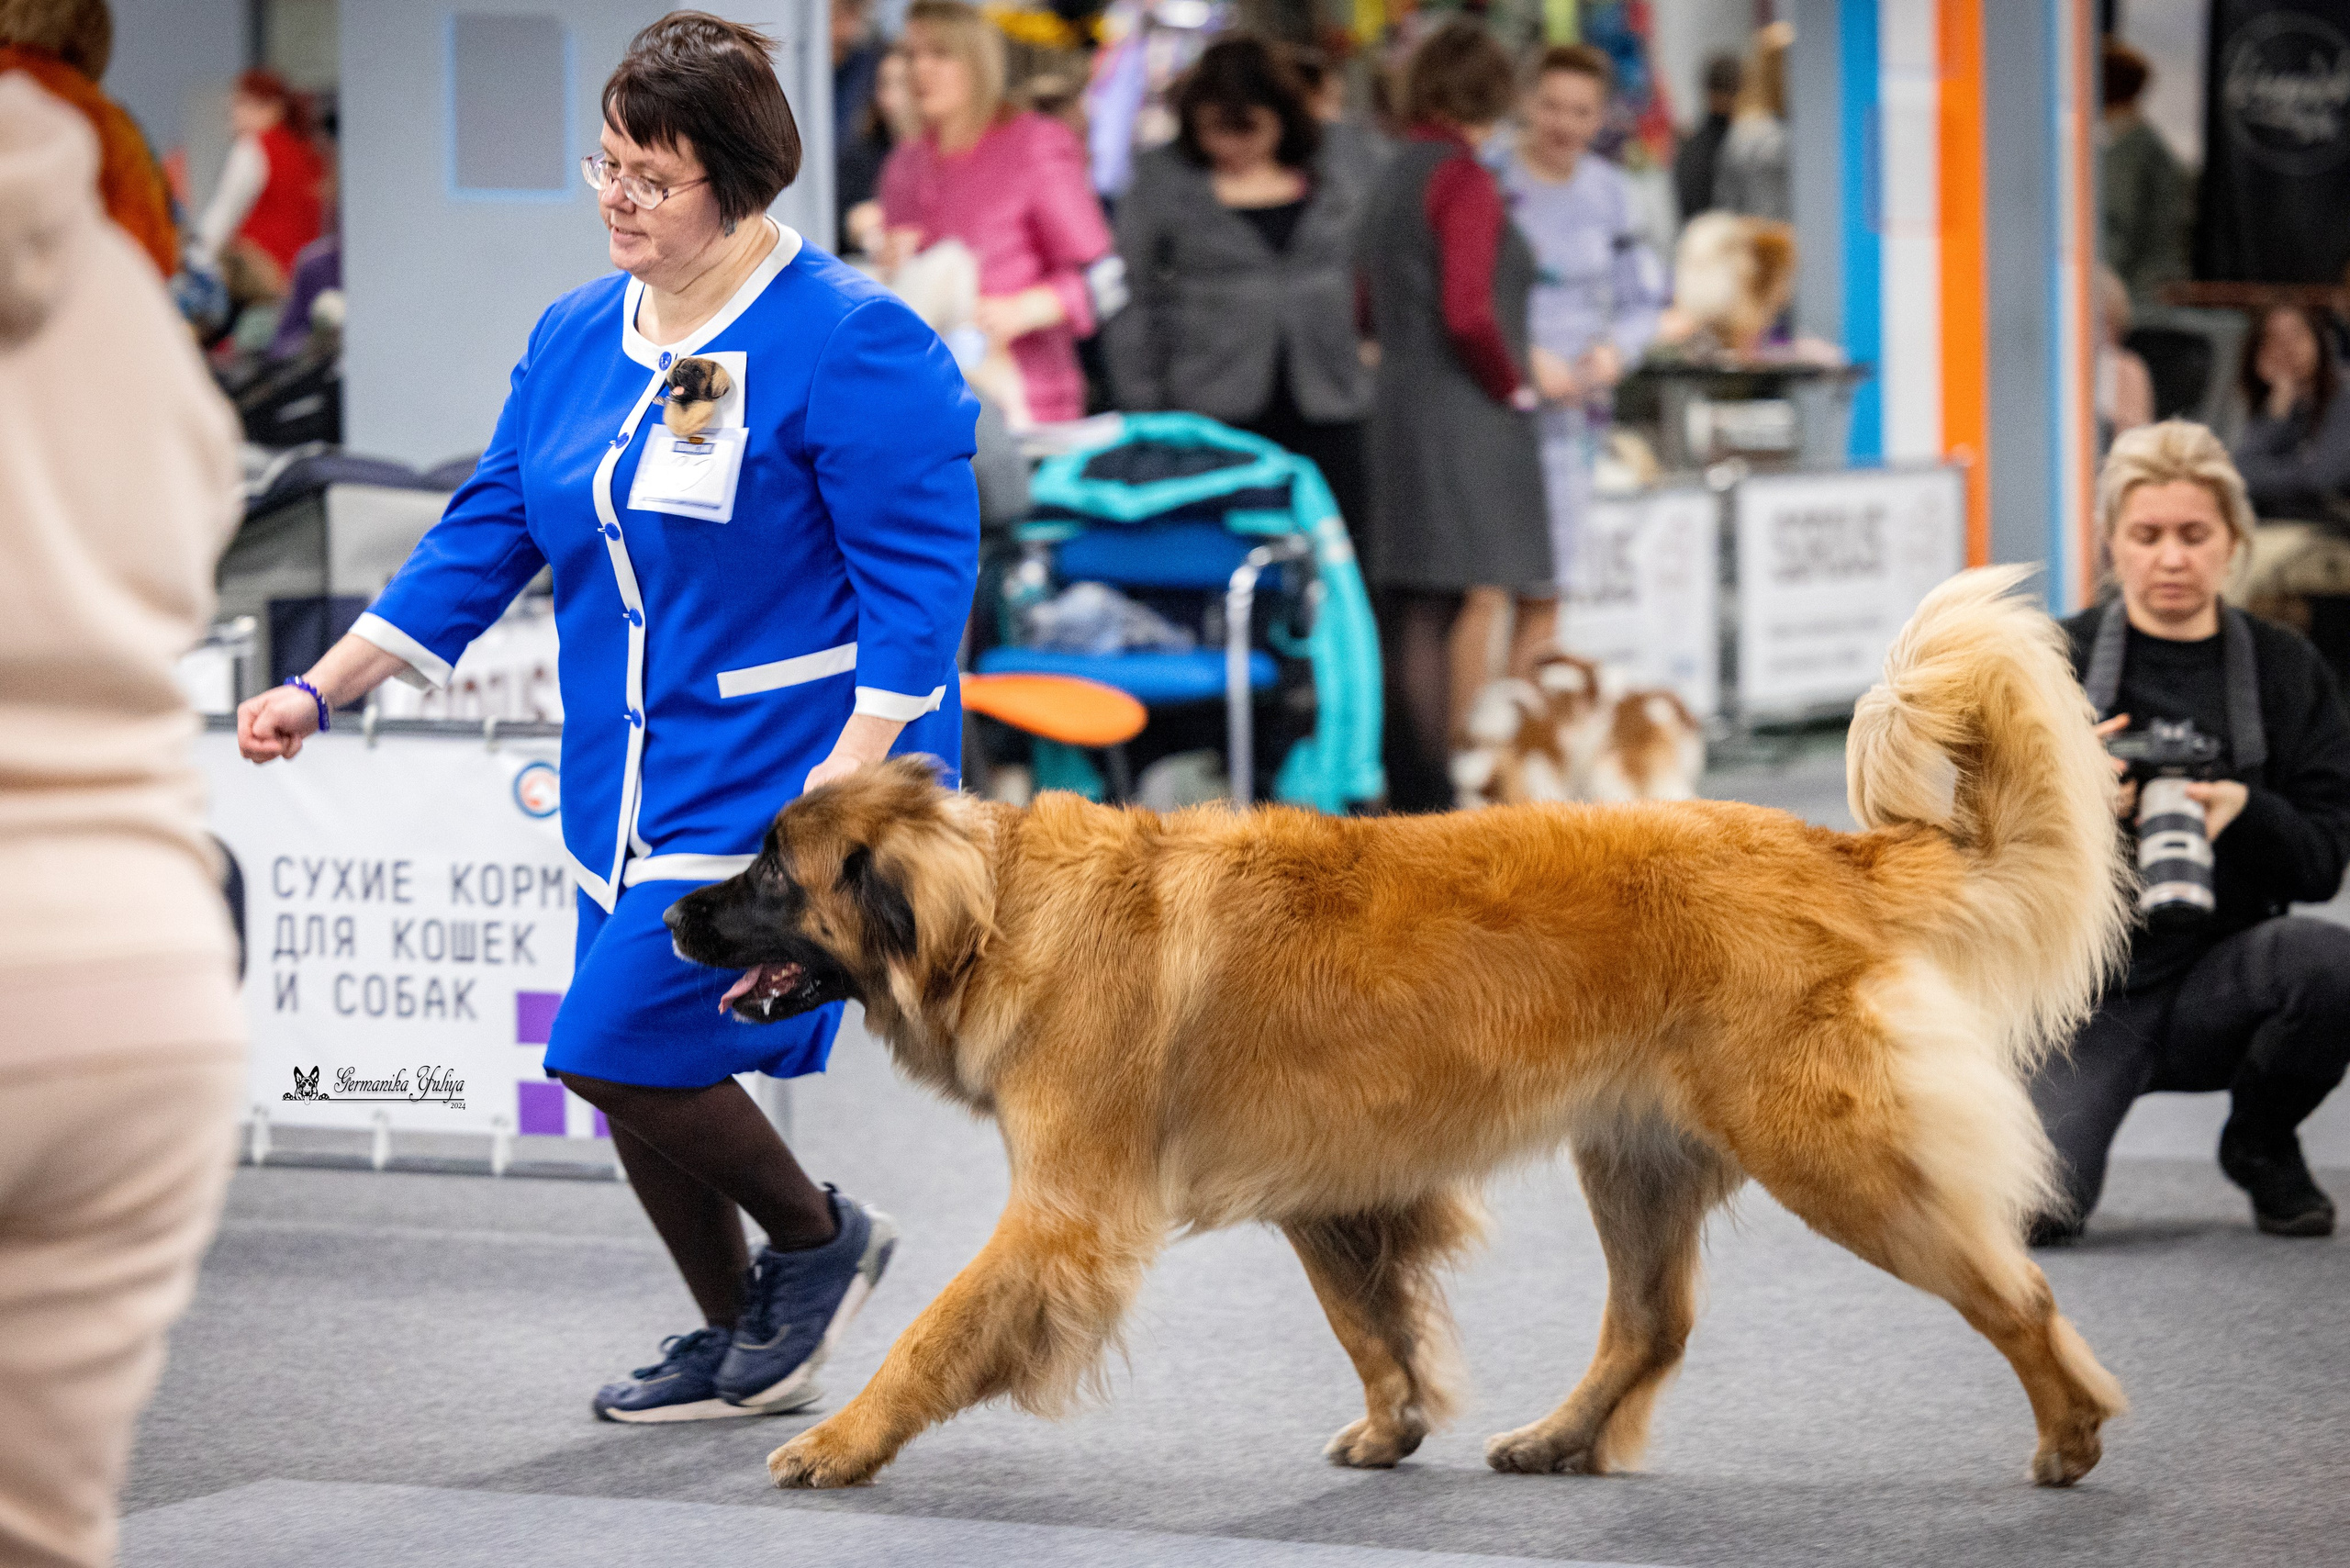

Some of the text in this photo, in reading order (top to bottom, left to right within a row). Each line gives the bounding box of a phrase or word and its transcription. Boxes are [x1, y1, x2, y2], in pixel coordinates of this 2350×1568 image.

[272, 855, 577, 909] СУХИЕ КОРМ
[273, 913, 537, 964] ДЛЯ КОШЕК
[275, 971, 477, 1021] И СОБАК
